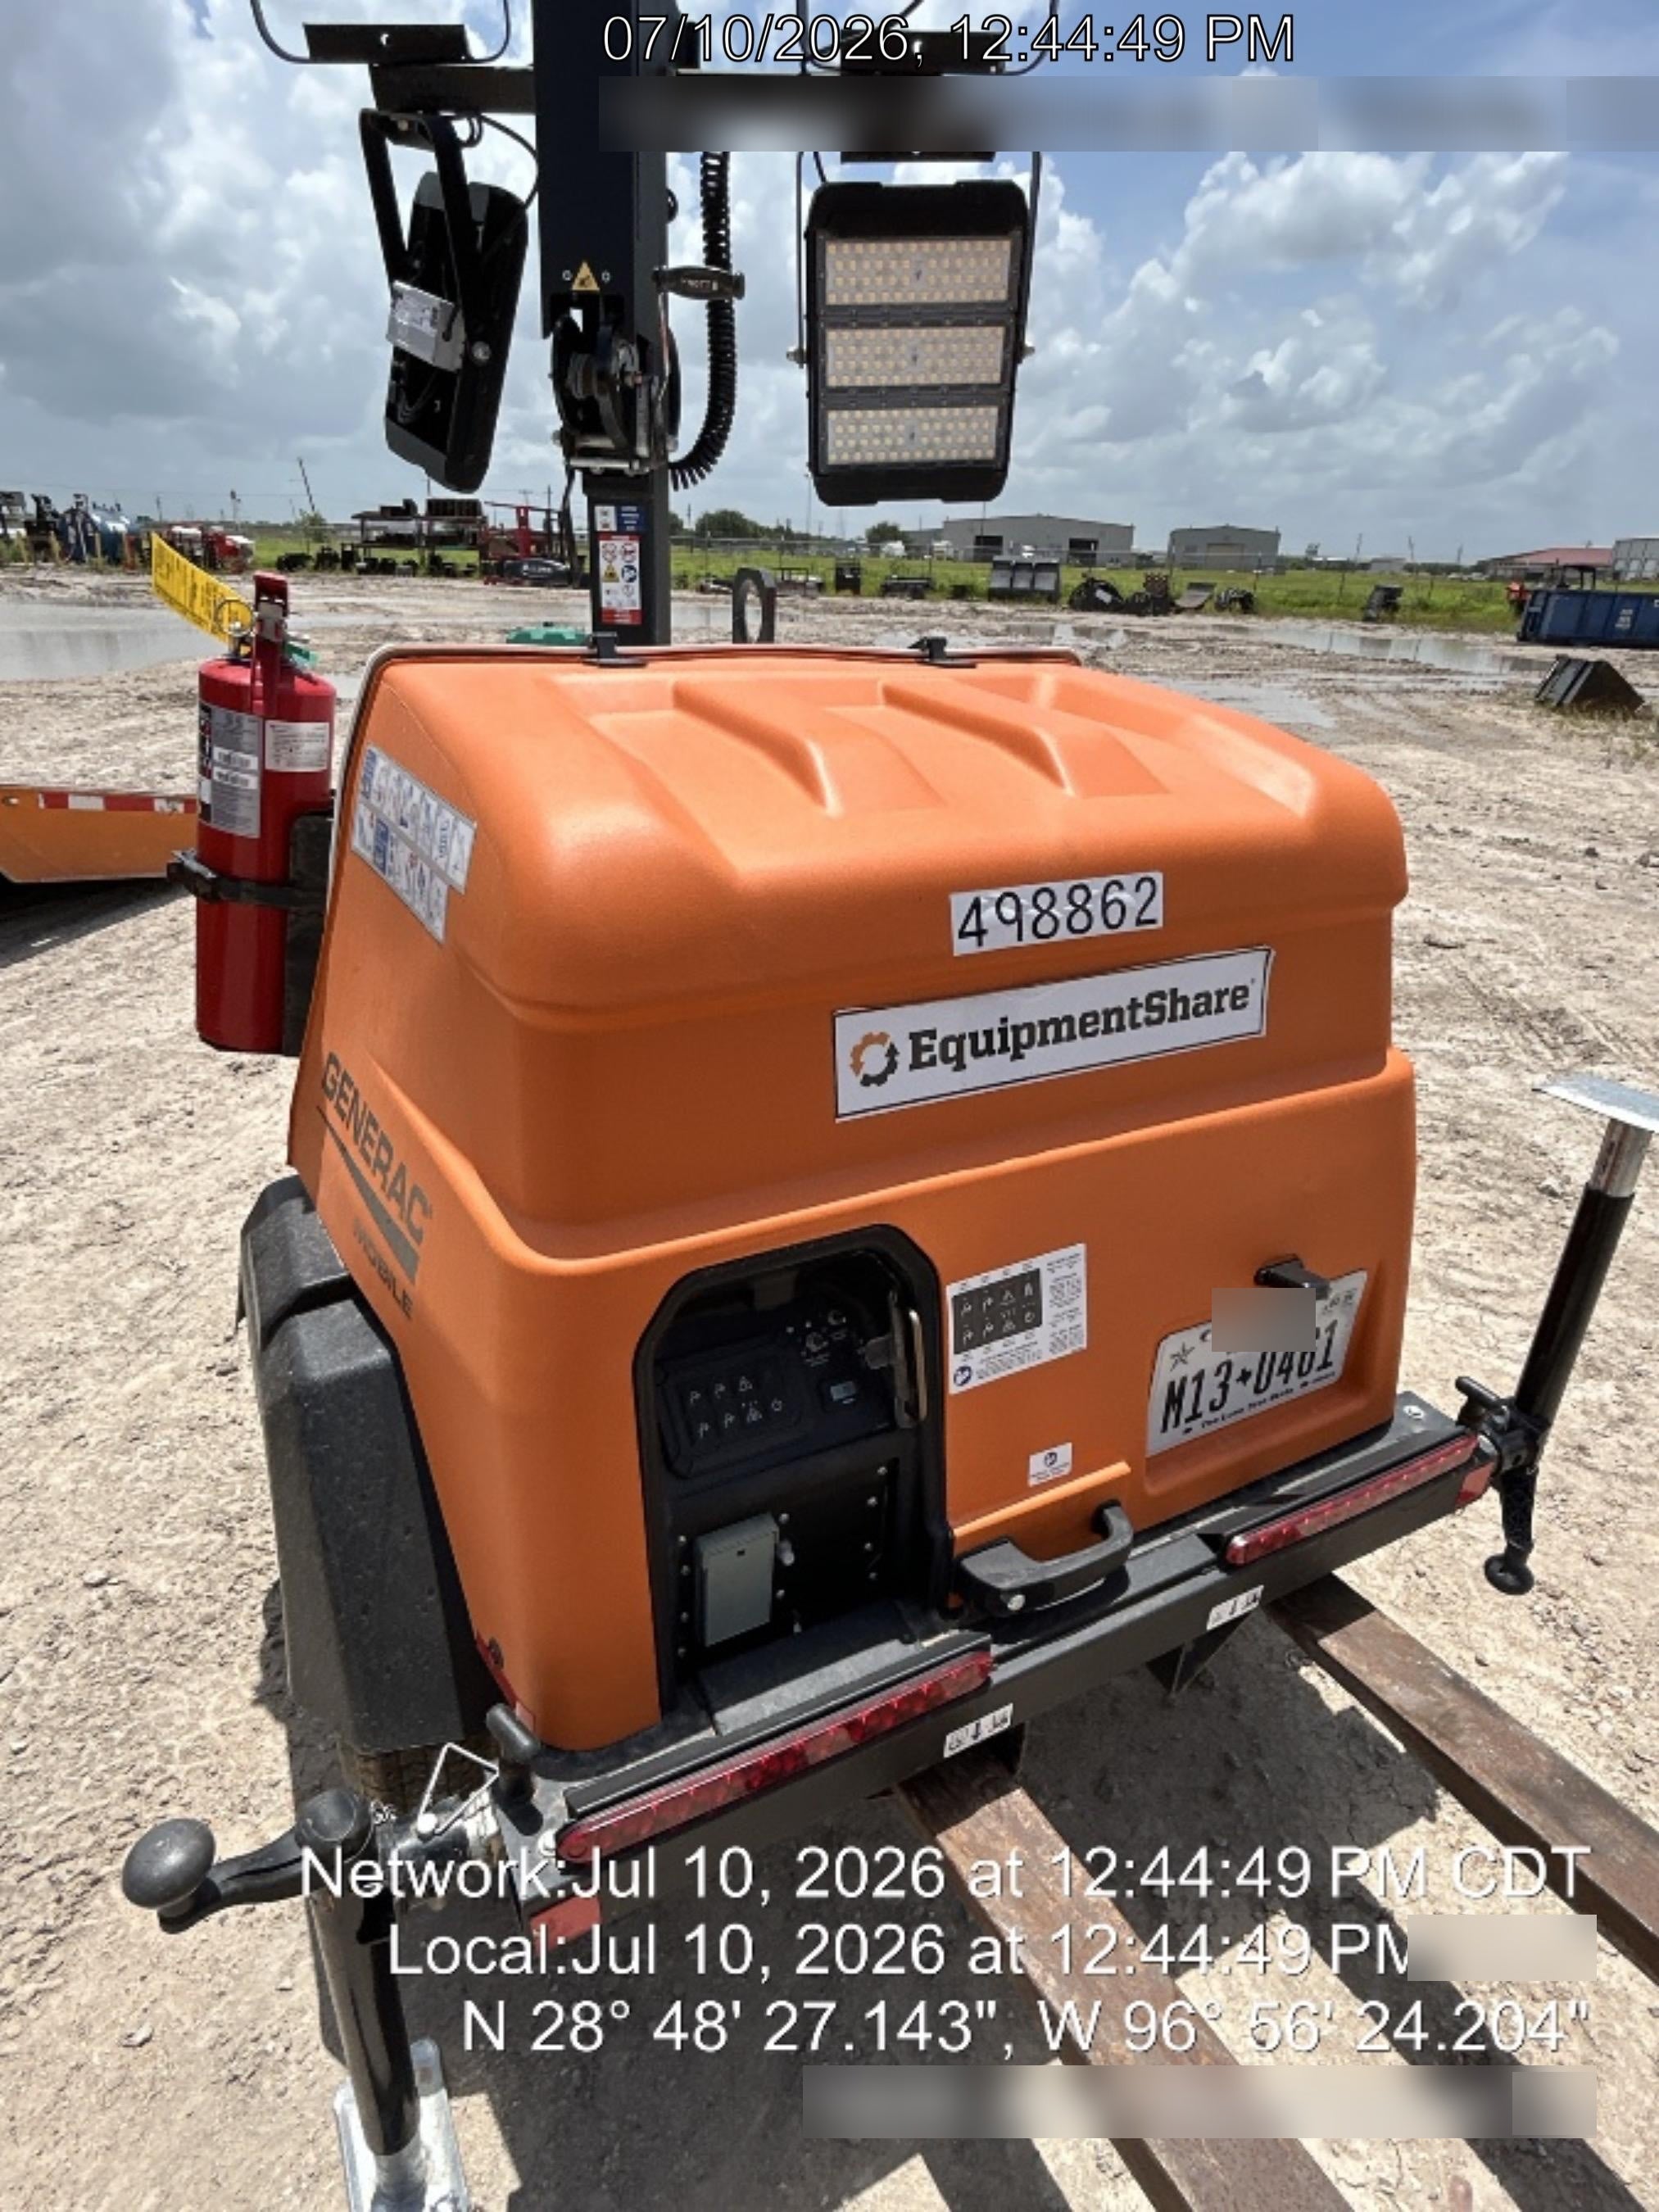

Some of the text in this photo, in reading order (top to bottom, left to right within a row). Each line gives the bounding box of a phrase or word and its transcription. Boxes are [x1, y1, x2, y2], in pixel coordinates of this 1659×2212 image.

[957, 877, 1158, 948] 498862
[909, 983, 1250, 1072] EquipmentShare
[321, 1050, 433, 1247] GENERAC
